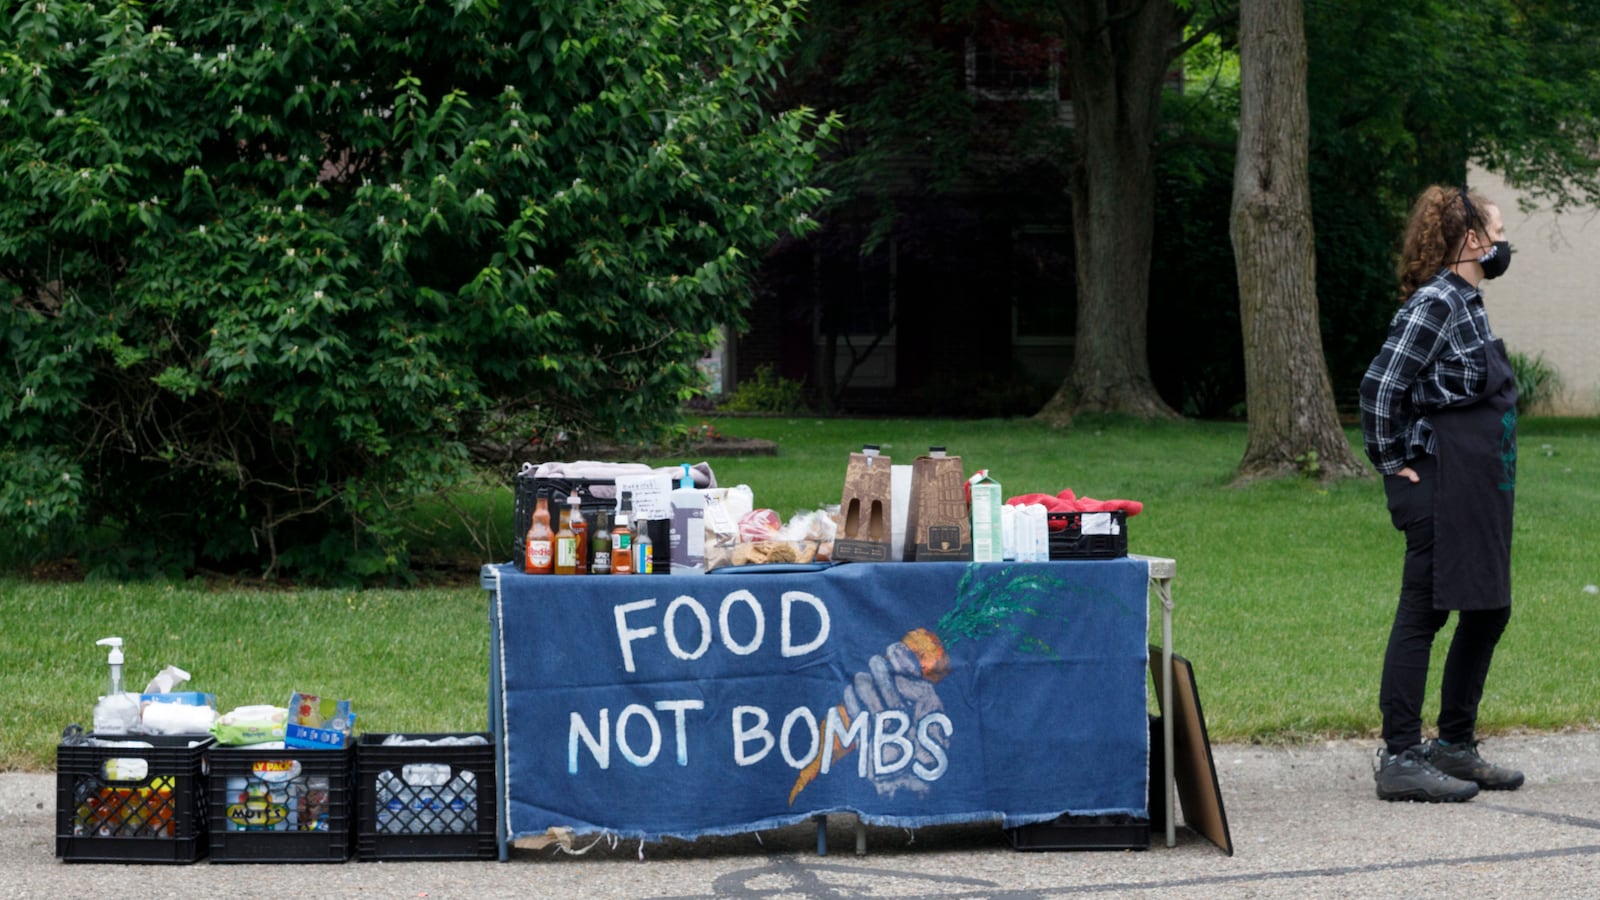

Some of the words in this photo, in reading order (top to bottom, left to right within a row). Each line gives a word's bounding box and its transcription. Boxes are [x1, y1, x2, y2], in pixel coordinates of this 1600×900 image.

[613, 588, 831, 673] FOOD
[567, 699, 704, 775] NOT
[731, 704, 954, 782] BOMBS
